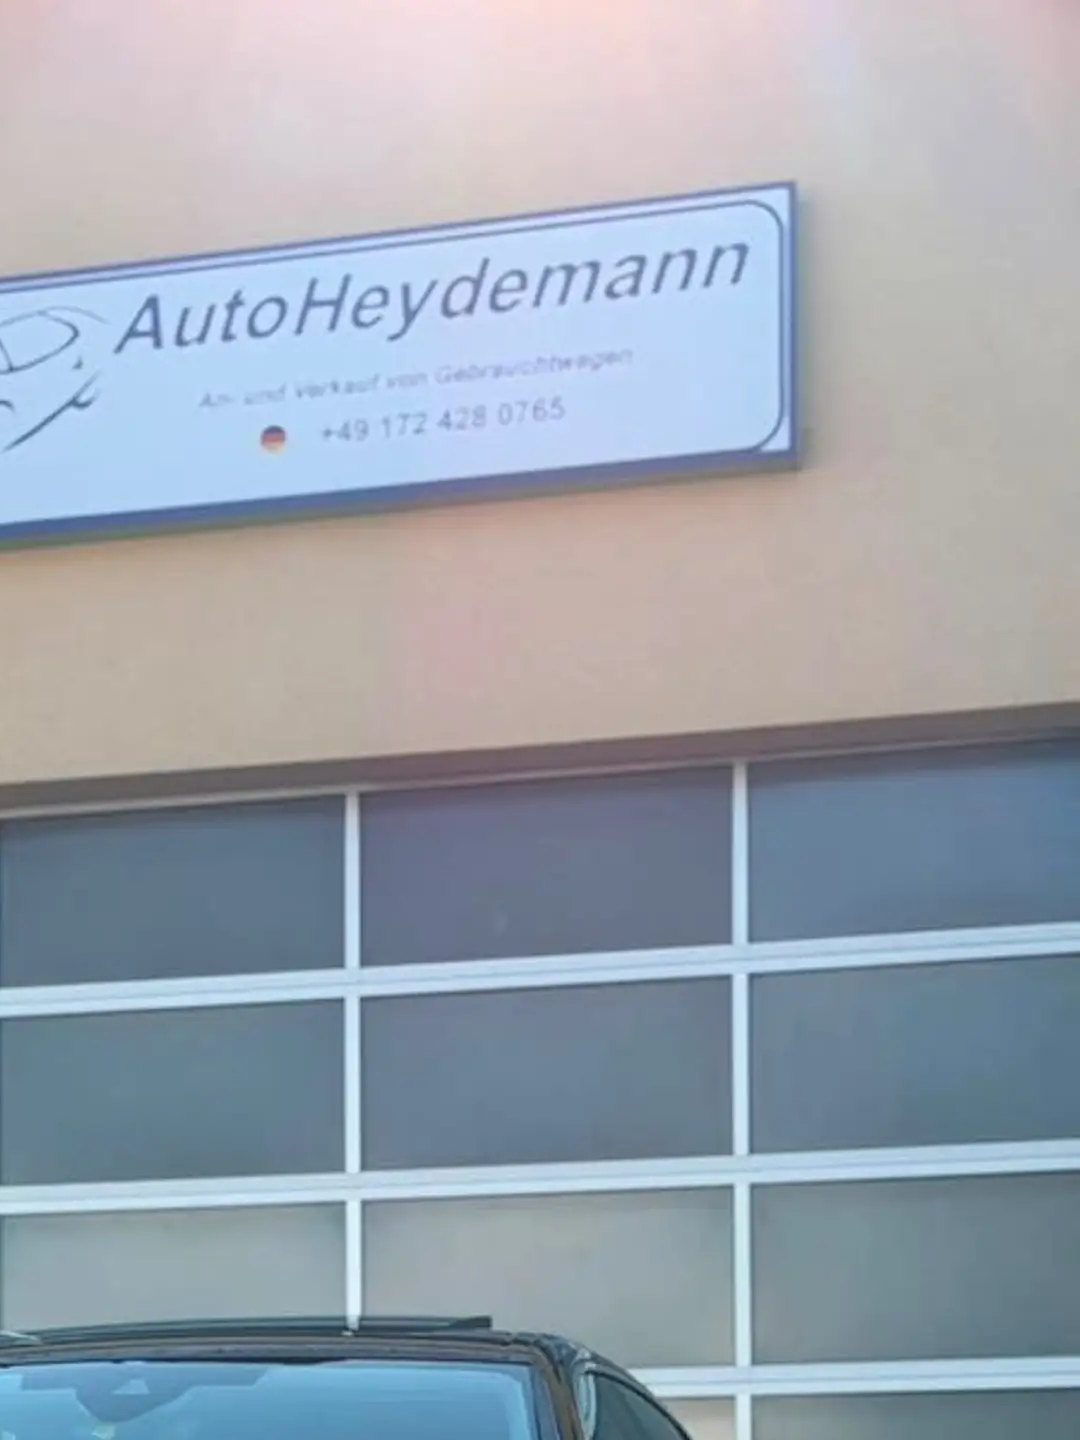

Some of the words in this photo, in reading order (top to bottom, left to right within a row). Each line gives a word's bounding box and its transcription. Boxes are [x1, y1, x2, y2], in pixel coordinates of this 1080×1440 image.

[113, 240, 751, 356] AutoHeydemann
[322, 419, 369, 442] +49
[381, 411, 428, 438] 172
[436, 404, 487, 431] 428
[497, 397, 566, 426] 0765
